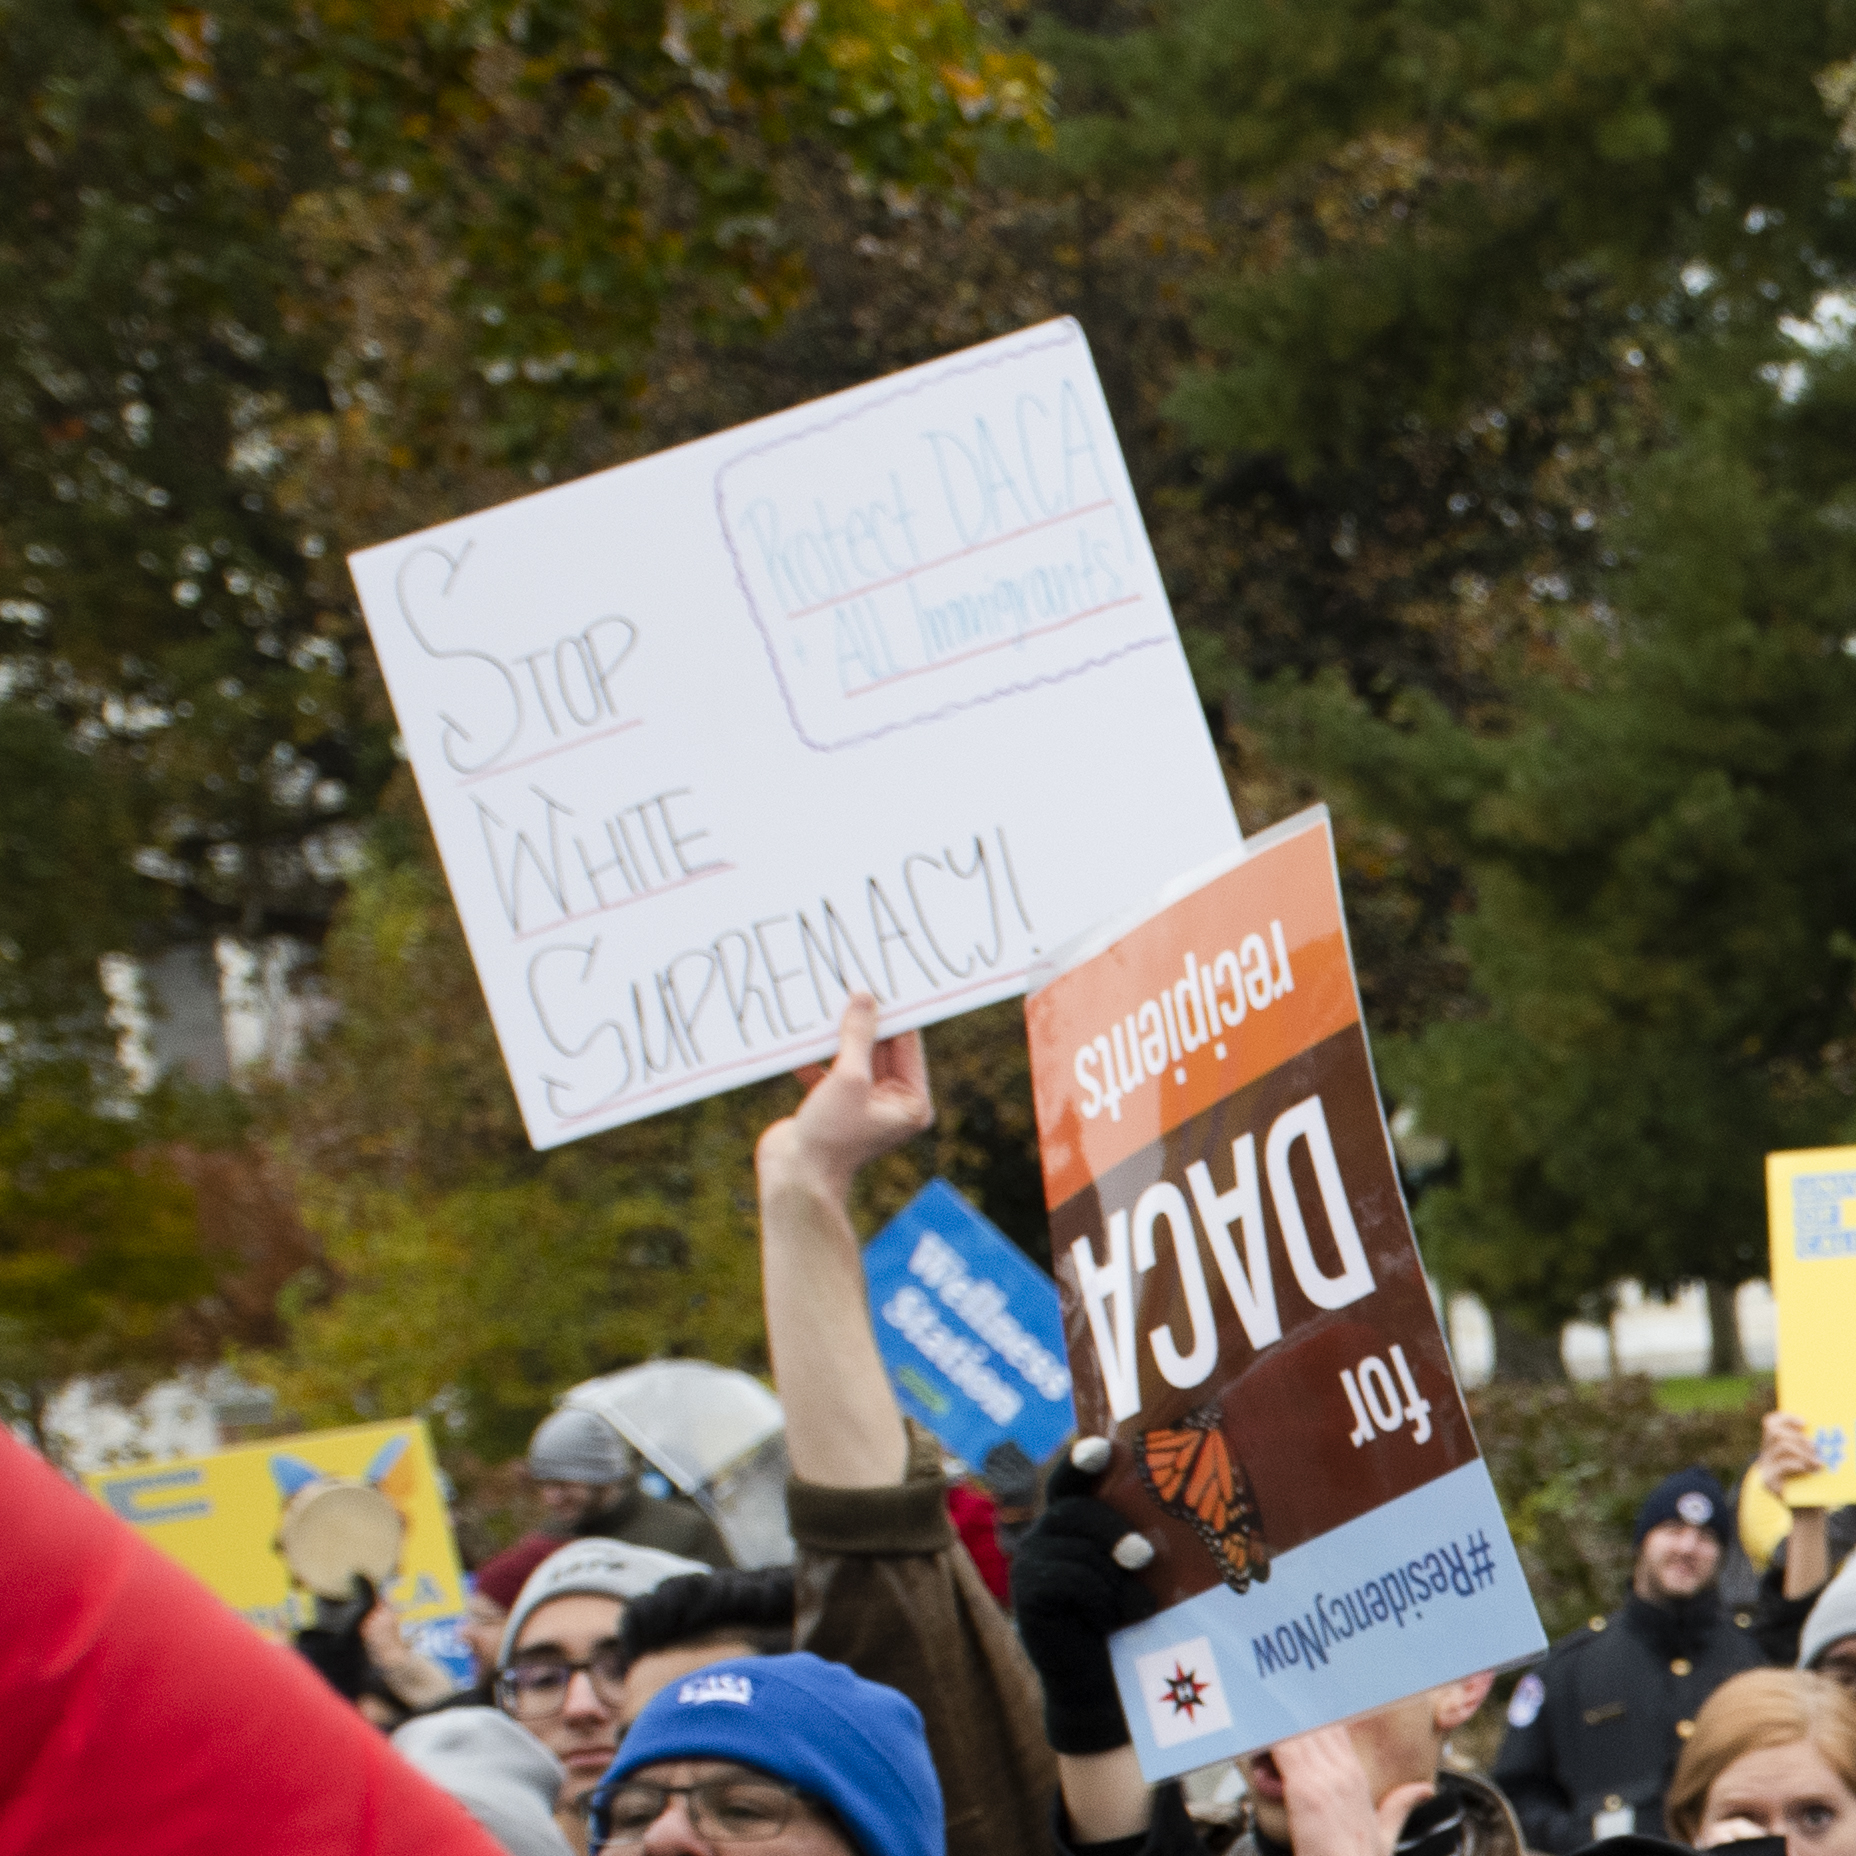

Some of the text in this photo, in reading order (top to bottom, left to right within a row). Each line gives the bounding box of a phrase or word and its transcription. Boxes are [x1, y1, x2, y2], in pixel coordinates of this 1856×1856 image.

[1074, 919, 1294, 1122] recipients
[1070, 1094, 1377, 1424] DACA
[1339, 1345, 1432, 1448] for
[1252, 1529, 1496, 1678] #ResidencyNow
